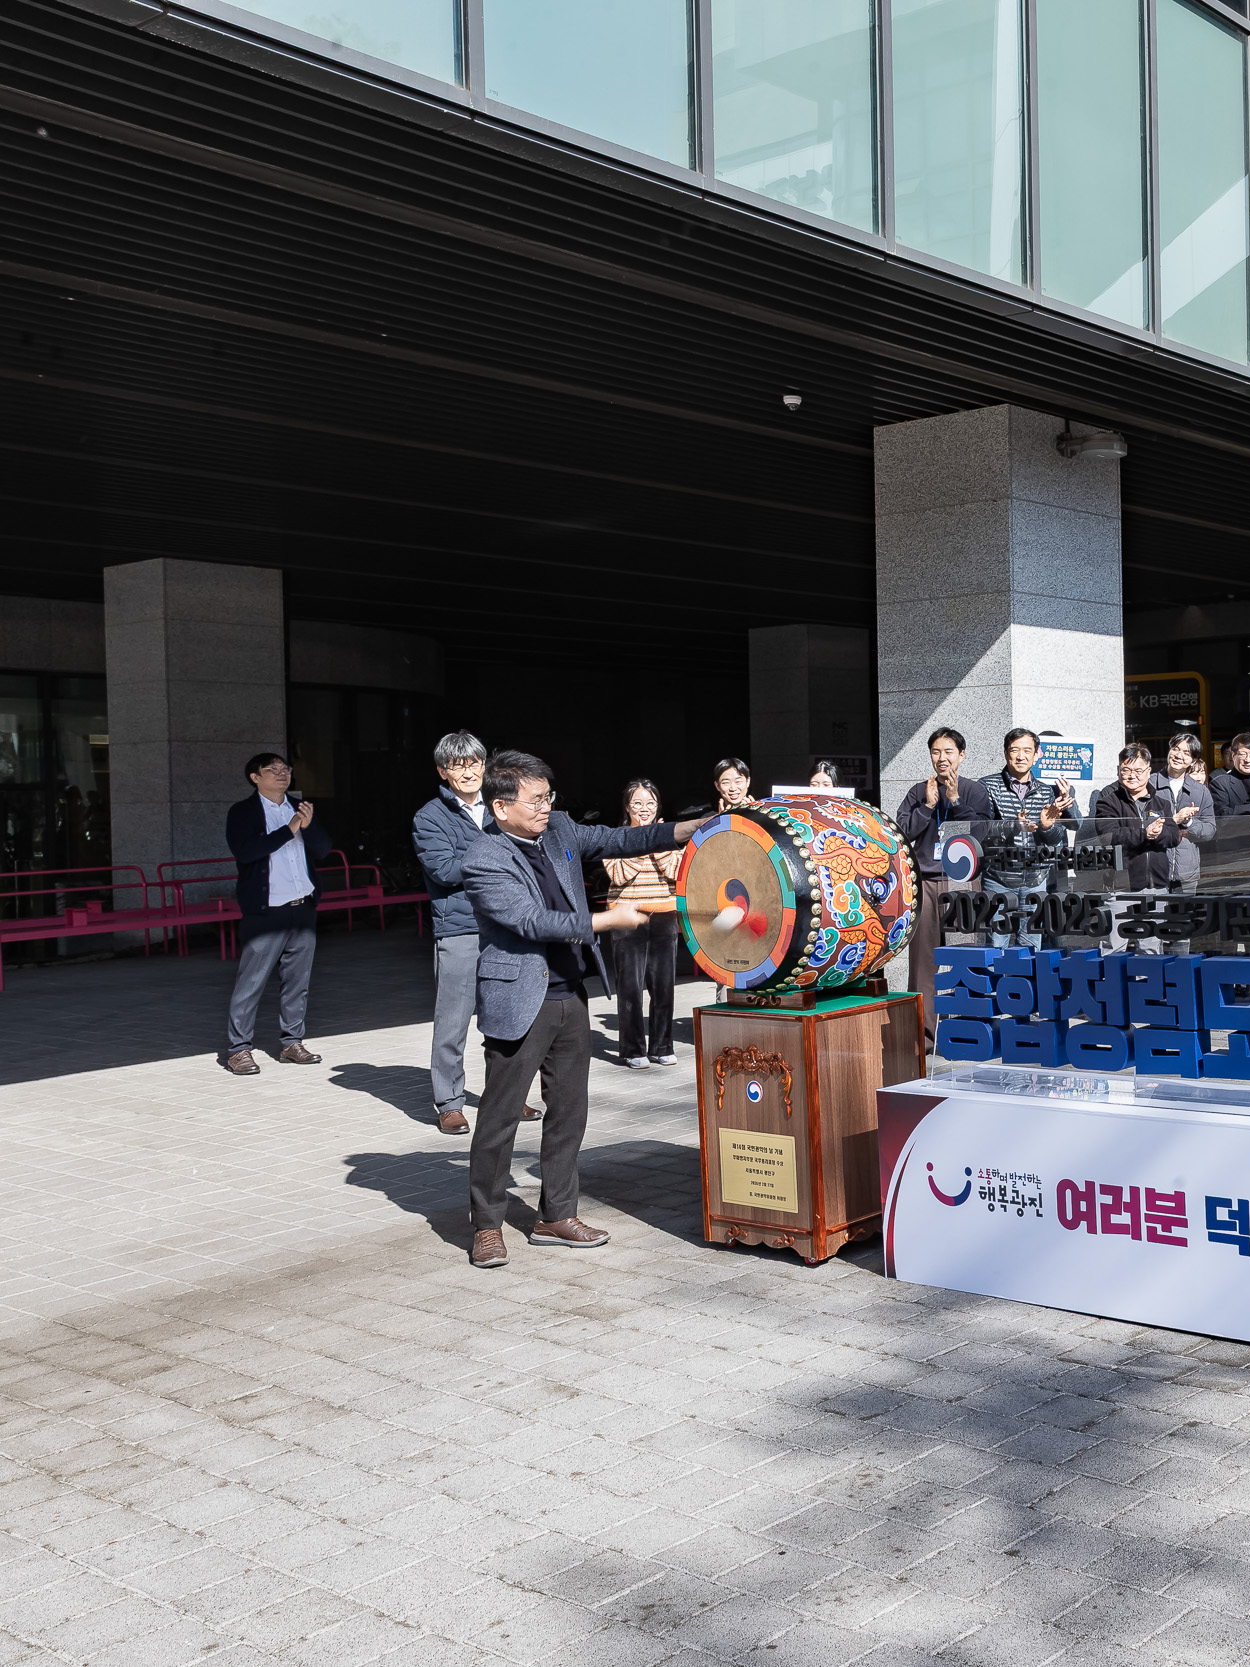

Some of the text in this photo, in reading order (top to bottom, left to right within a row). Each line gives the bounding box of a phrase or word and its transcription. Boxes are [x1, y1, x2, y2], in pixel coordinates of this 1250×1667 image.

[938, 891, 1113, 936] 2023-2025
[978, 1168, 1042, 1190] 소통하며 발전하는
[978, 1185, 1044, 1218] 행복광진
[1056, 1178, 1189, 1248] 여러분
